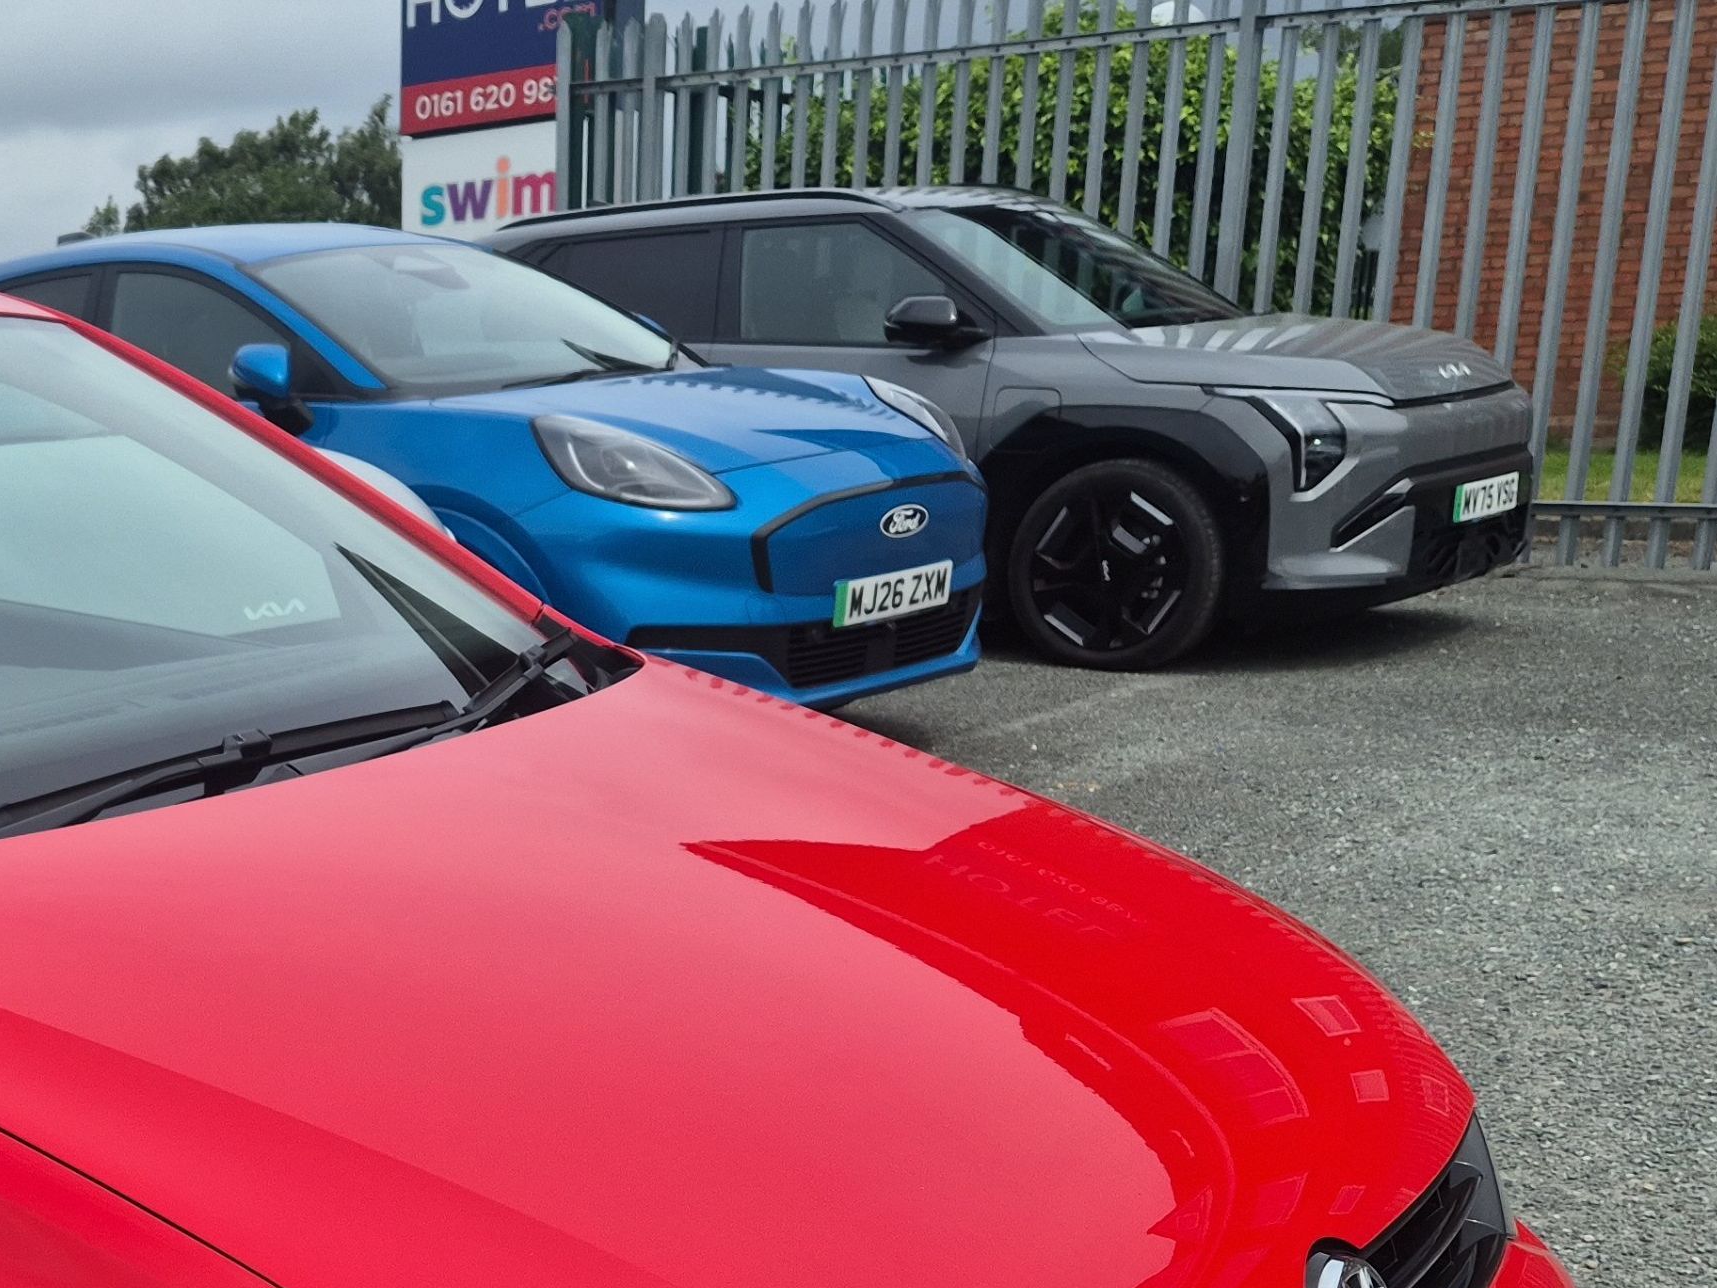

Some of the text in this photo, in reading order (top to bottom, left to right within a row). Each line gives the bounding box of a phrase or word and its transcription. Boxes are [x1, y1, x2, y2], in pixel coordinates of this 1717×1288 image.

[415, 76, 557, 120] 0161 620 98
[421, 155, 556, 227] swim
[889, 509, 921, 534] Ford
[849, 568, 948, 618] MJ26 ZXM
